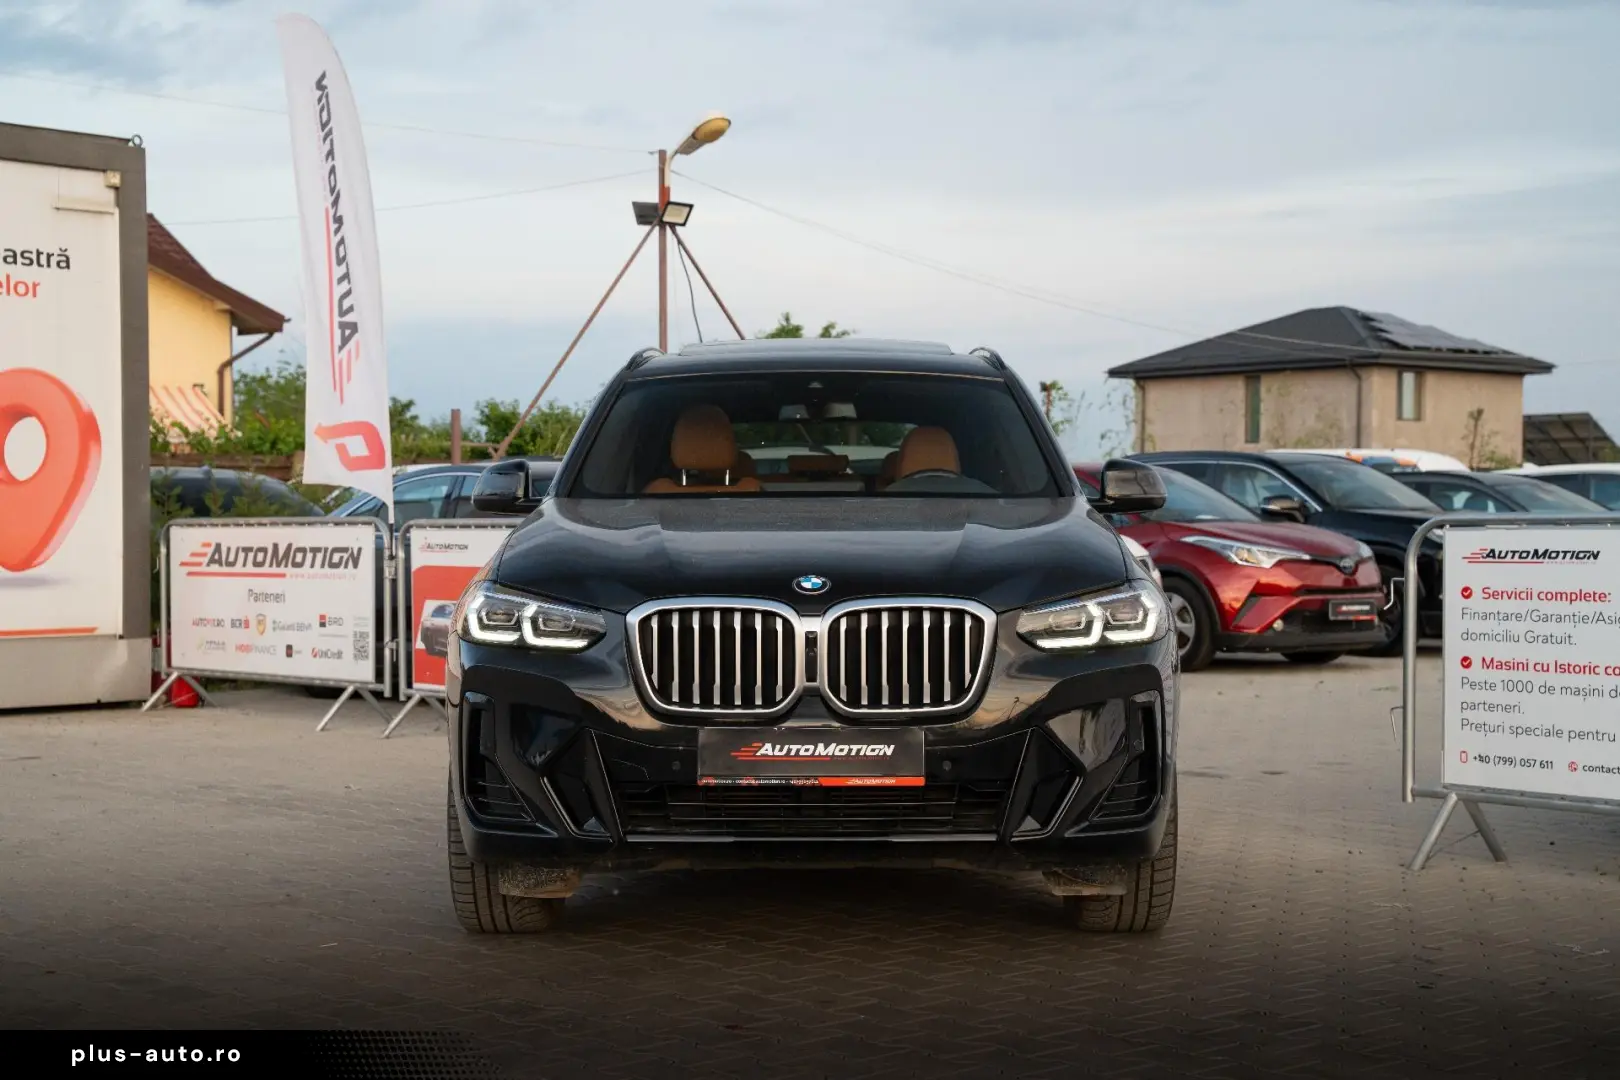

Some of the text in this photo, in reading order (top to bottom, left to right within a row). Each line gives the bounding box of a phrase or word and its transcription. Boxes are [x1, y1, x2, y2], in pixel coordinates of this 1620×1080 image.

[2, 247, 71, 270] astră
[0, 272, 41, 298] lor
[248, 588, 286, 604] Parteneri
[1481, 586, 1612, 605] Servicii complete:
[1461, 607, 1620, 629] Finanțare/Garanție/Asi
[1460, 628, 1577, 646] domiciliu Gratuit.
[1481, 656, 1529, 672] Masini
[1533, 663, 1550, 673] cu
[1554, 659, 1601, 676] Istoric
[1461, 676, 1620, 702] Peste 1000 de mașini d
[1460, 700, 1525, 714] parteneri.
[1461, 717, 1616, 743] Prețuri speciale pentru
[1493, 754, 1517, 768] (799)
[1519, 757, 1537, 768] 057
[1540, 759, 1554, 770] 611
[1582, 764, 1620, 775] contact
